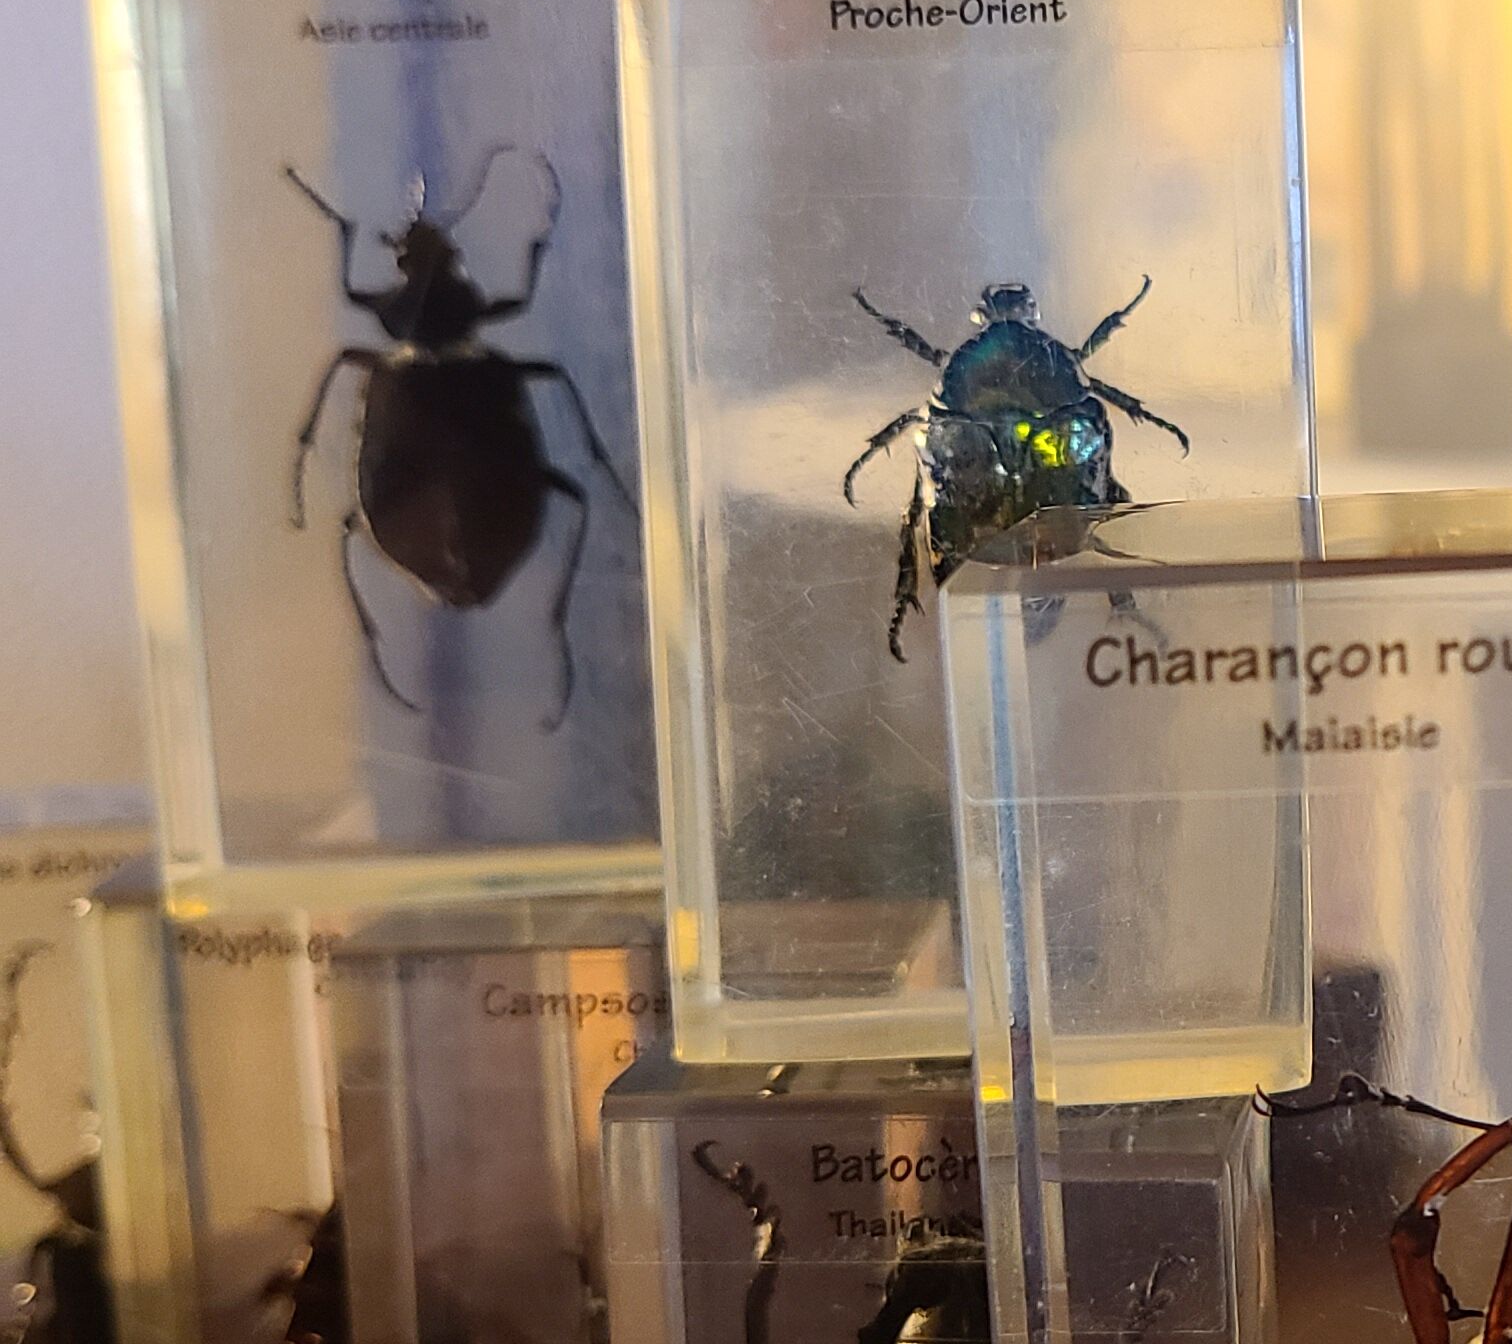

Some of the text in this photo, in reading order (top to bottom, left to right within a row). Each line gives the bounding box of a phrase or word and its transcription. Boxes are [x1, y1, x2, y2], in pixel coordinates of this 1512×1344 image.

[302, 15, 492, 43] Asie centrale
[1086, 635, 1410, 695] Charançon
